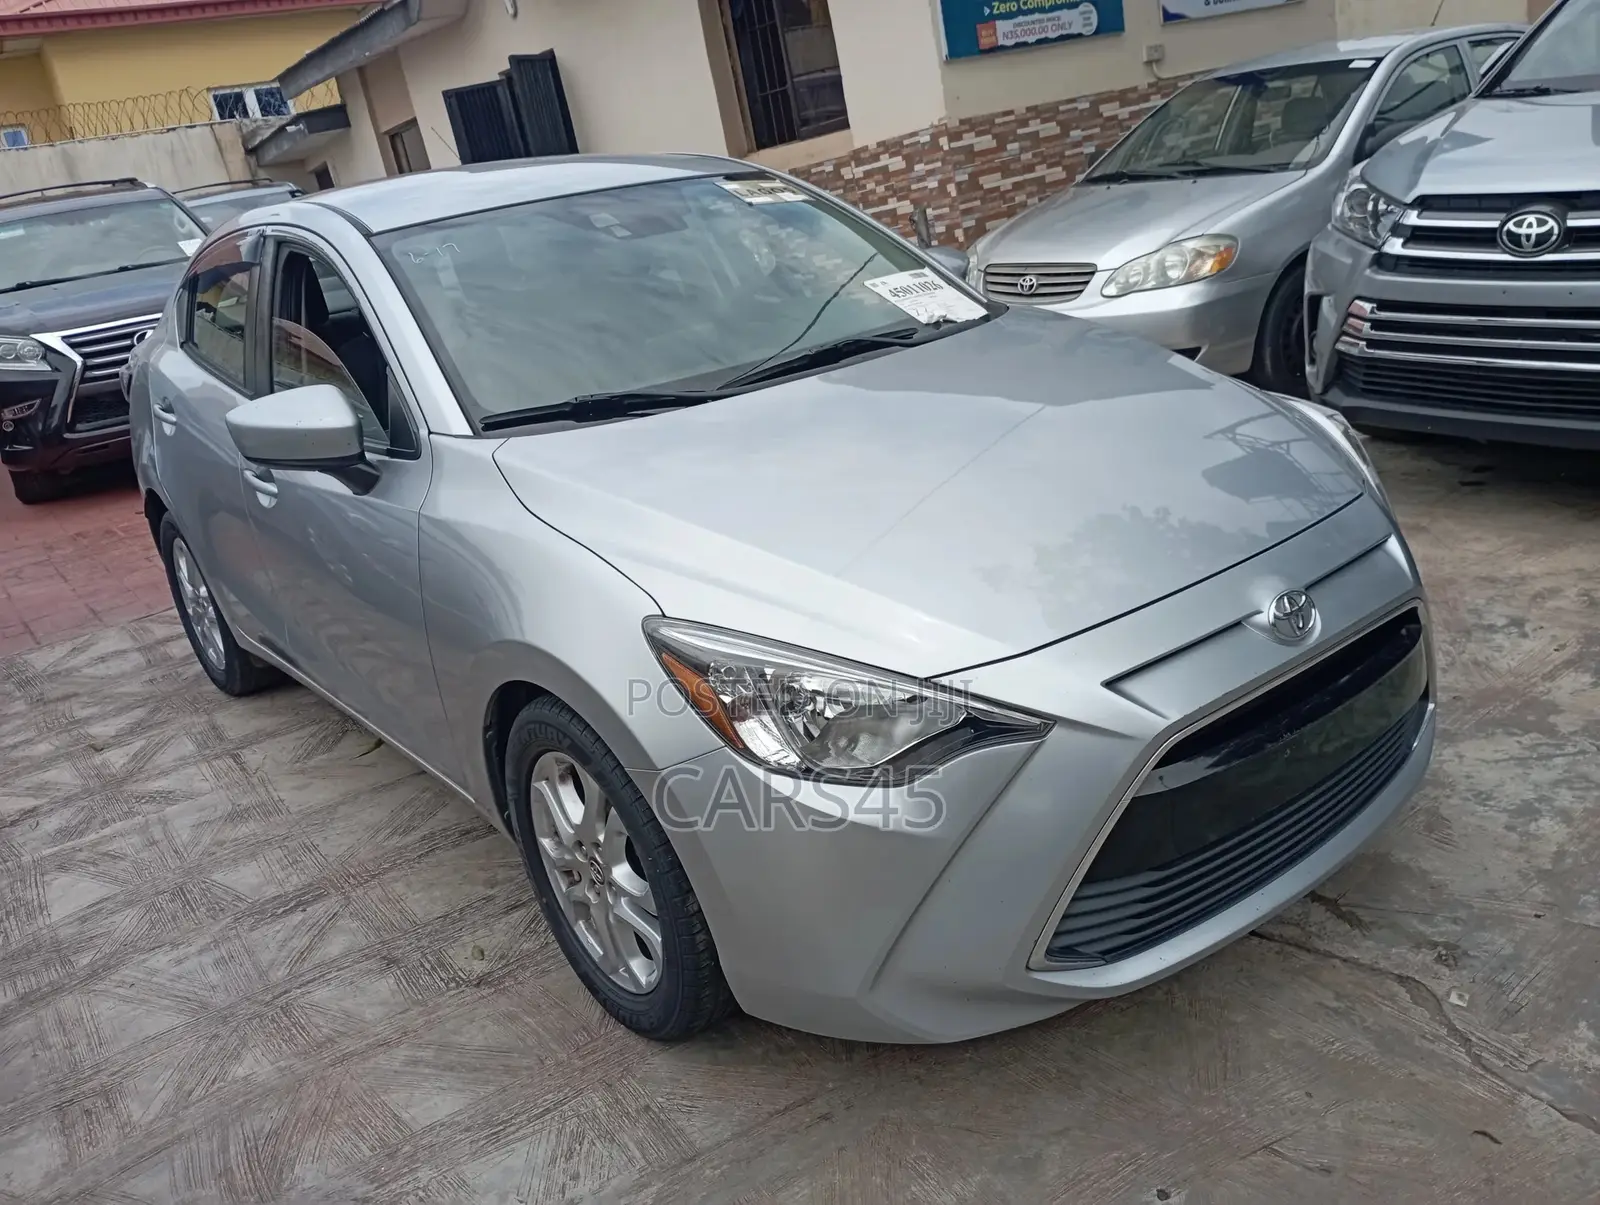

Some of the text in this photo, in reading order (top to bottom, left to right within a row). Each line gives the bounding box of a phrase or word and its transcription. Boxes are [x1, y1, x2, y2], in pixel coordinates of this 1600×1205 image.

[991, 2, 1018, 15] Zero
[1050, 20, 1074, 32] ONLY
[888, 280, 944, 299] 45011026
